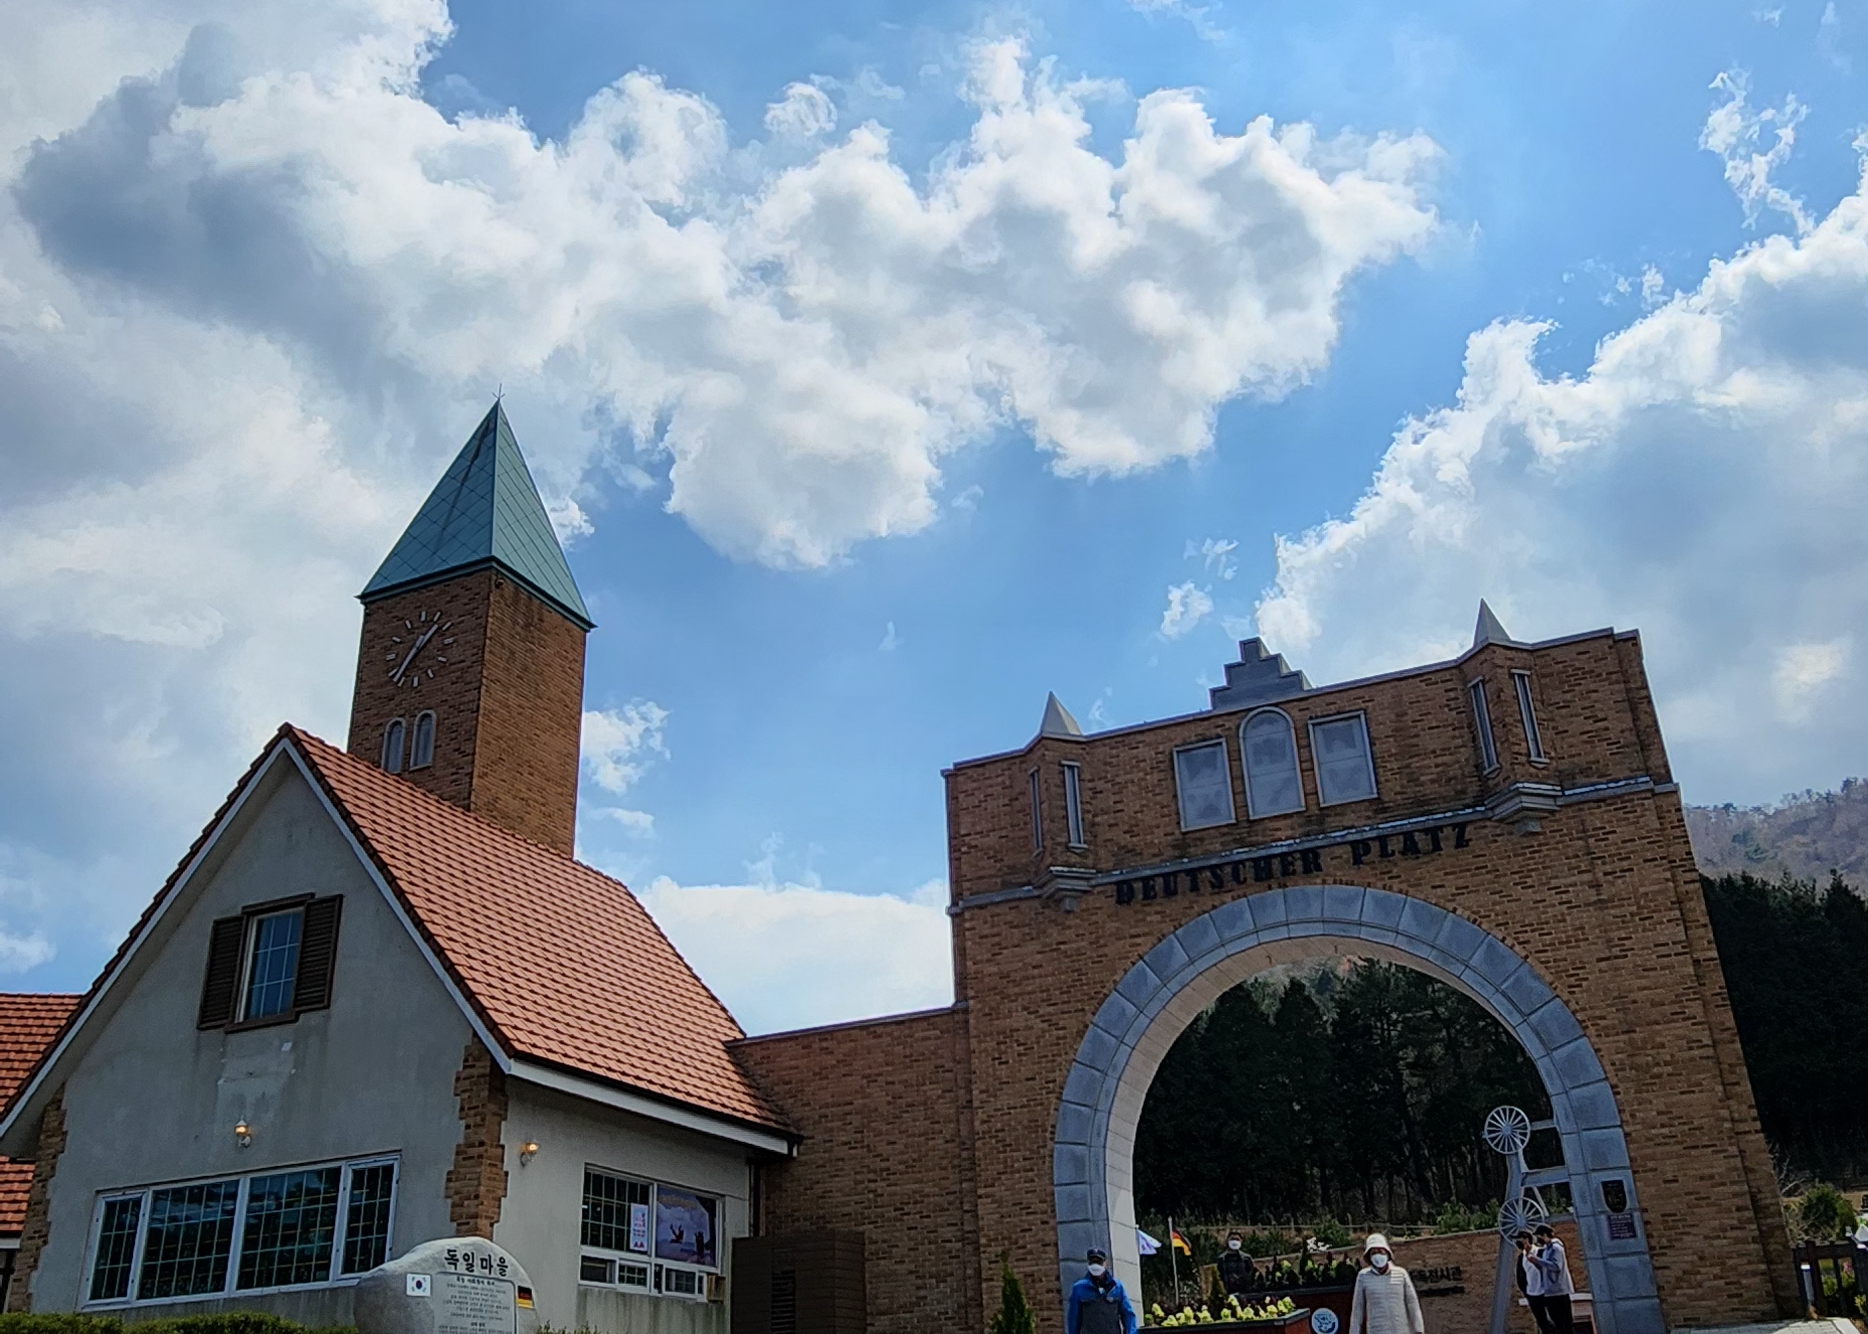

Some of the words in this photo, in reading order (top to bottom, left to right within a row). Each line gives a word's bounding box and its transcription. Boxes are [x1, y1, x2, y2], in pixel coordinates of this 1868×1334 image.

[1115, 847, 1323, 905] DEUTSCHER
[1351, 822, 1471, 867] PLATZ
[444, 1248, 509, 1278] 독일마을
